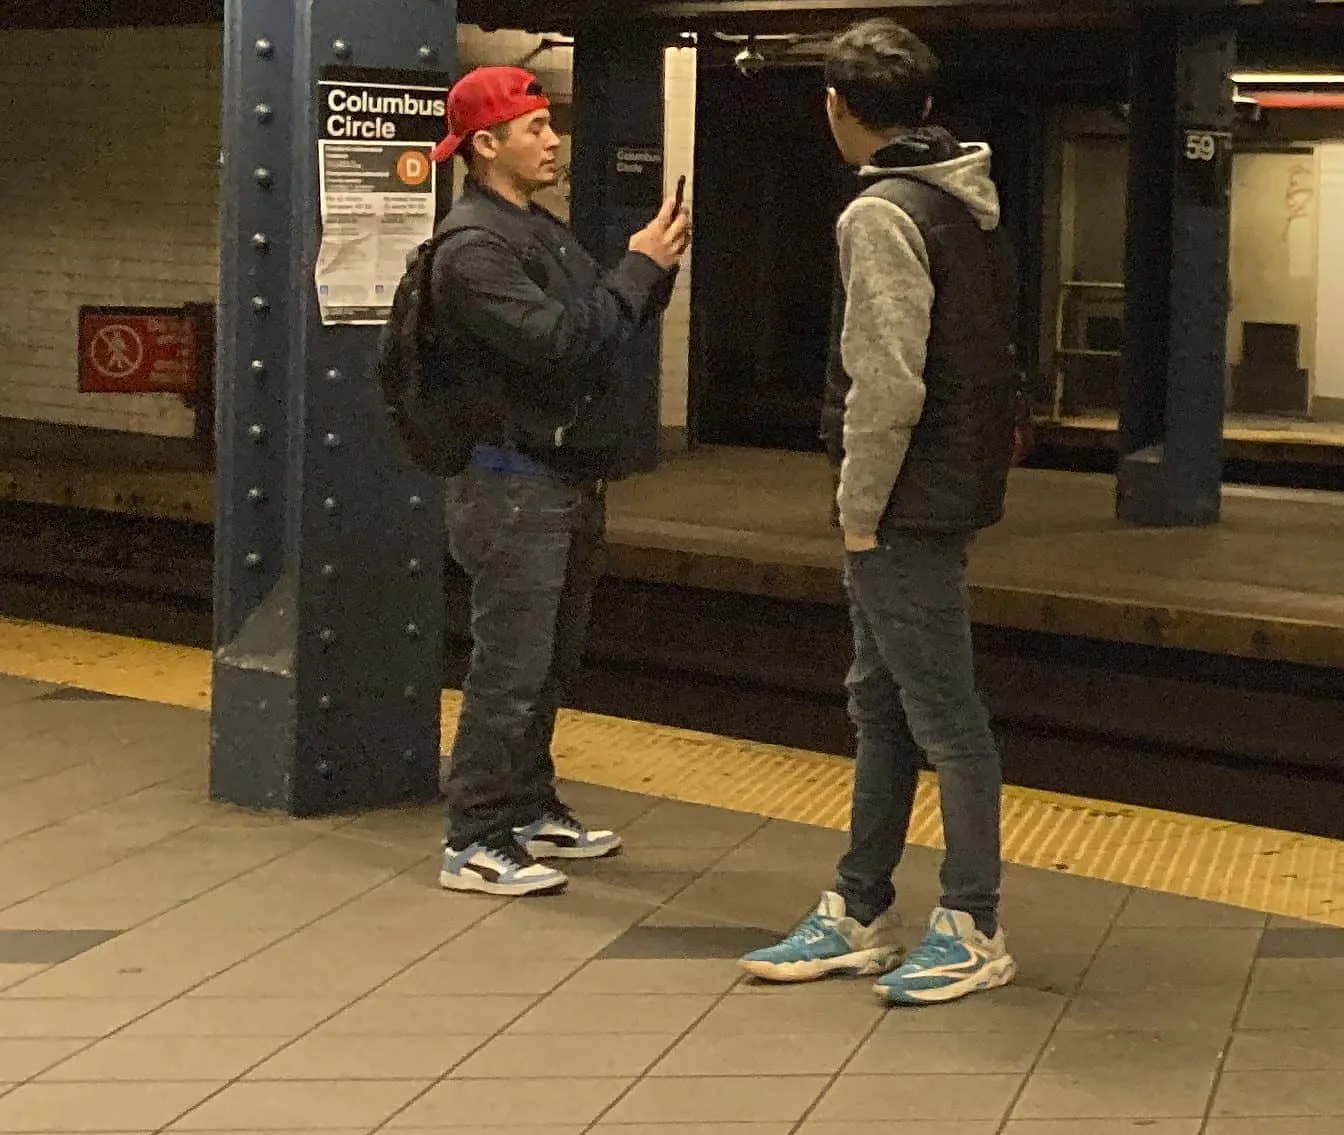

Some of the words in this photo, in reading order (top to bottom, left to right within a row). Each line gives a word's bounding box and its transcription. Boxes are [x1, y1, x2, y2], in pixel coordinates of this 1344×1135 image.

[327, 89, 446, 117] Columbus
[326, 115, 396, 139] Circle
[1186, 135, 1215, 161] 59
[406, 158, 422, 179] D
